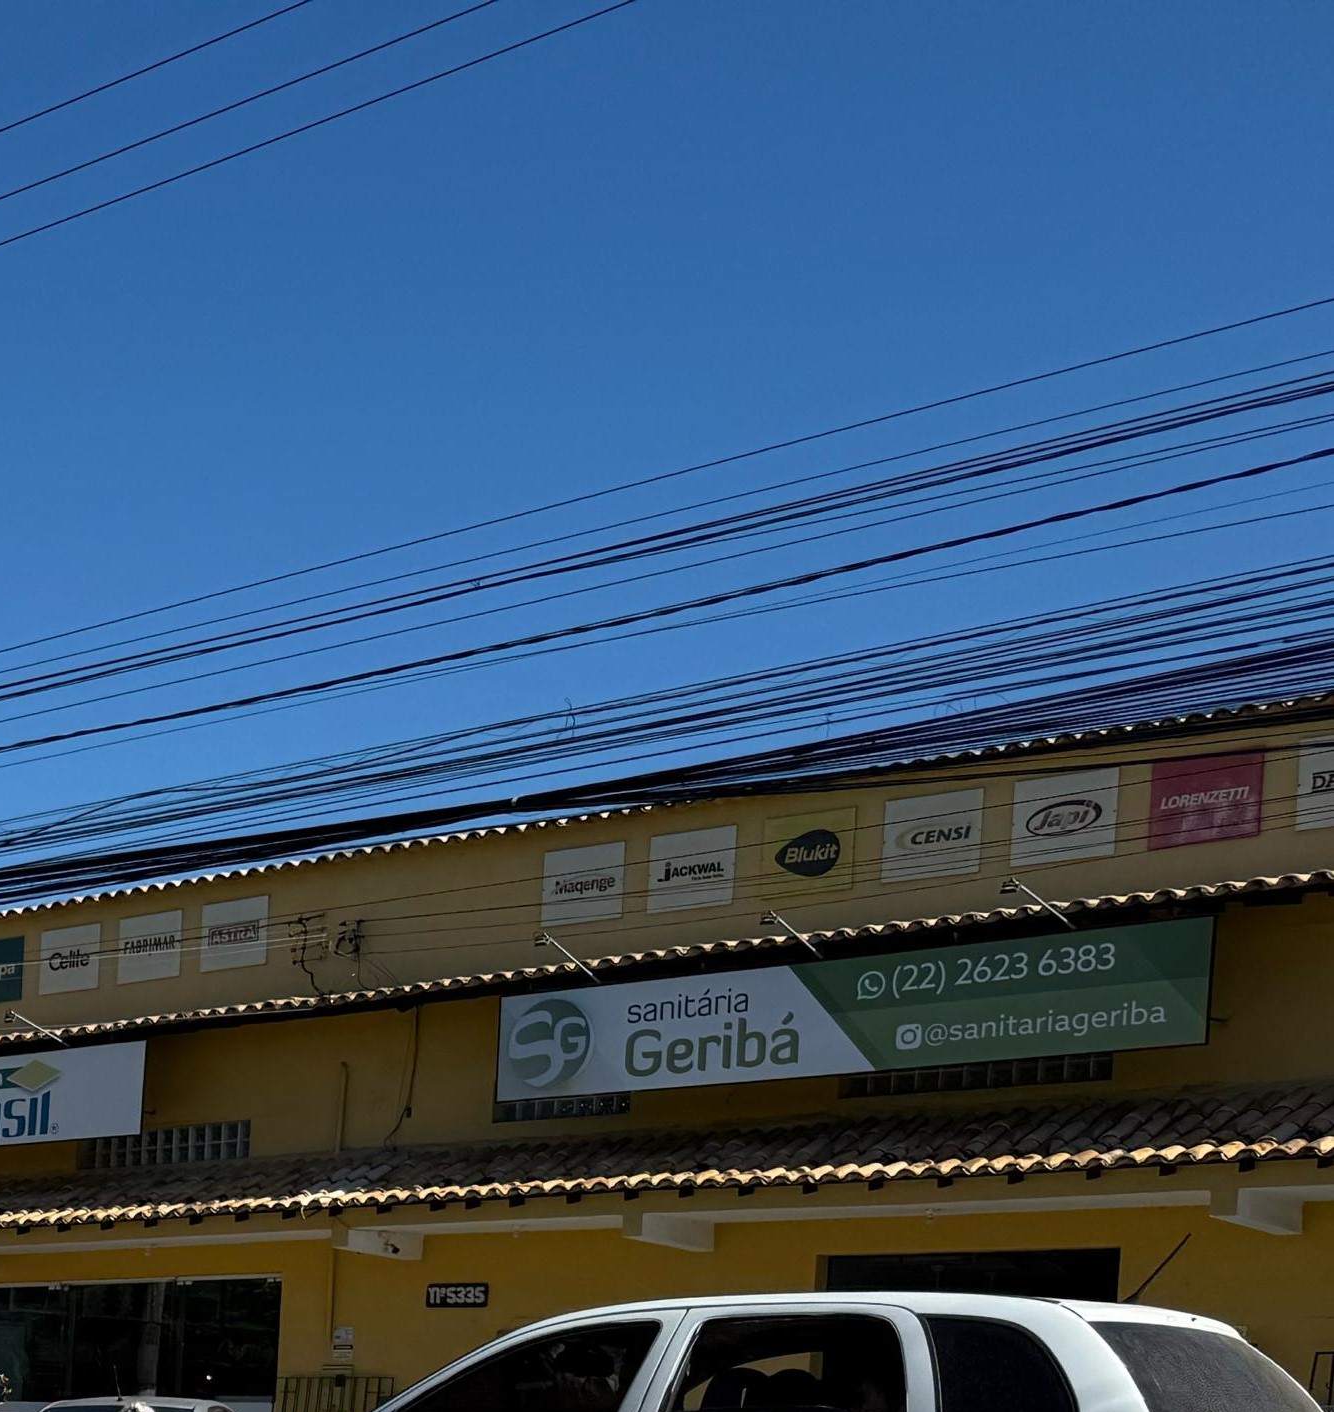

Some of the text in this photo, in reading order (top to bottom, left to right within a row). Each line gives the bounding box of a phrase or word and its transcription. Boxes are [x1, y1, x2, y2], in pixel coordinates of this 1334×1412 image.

[1160, 786, 1249, 809] LORENZETTI
[1034, 801, 1090, 834] Japi
[910, 824, 972, 845] CENSI
[785, 843, 838, 864] Blukit
[124, 934, 176, 956] FABRIMAR
[211, 924, 257, 945] ASTRA
[48, 949, 90, 971] Celite
[892, 943, 1116, 999] (22) 2623 6383
[628, 988, 749, 1024] sanitária
[924, 1000, 1167, 1047] @sanitariageriba
[625, 1010, 800, 1077] Geribá
